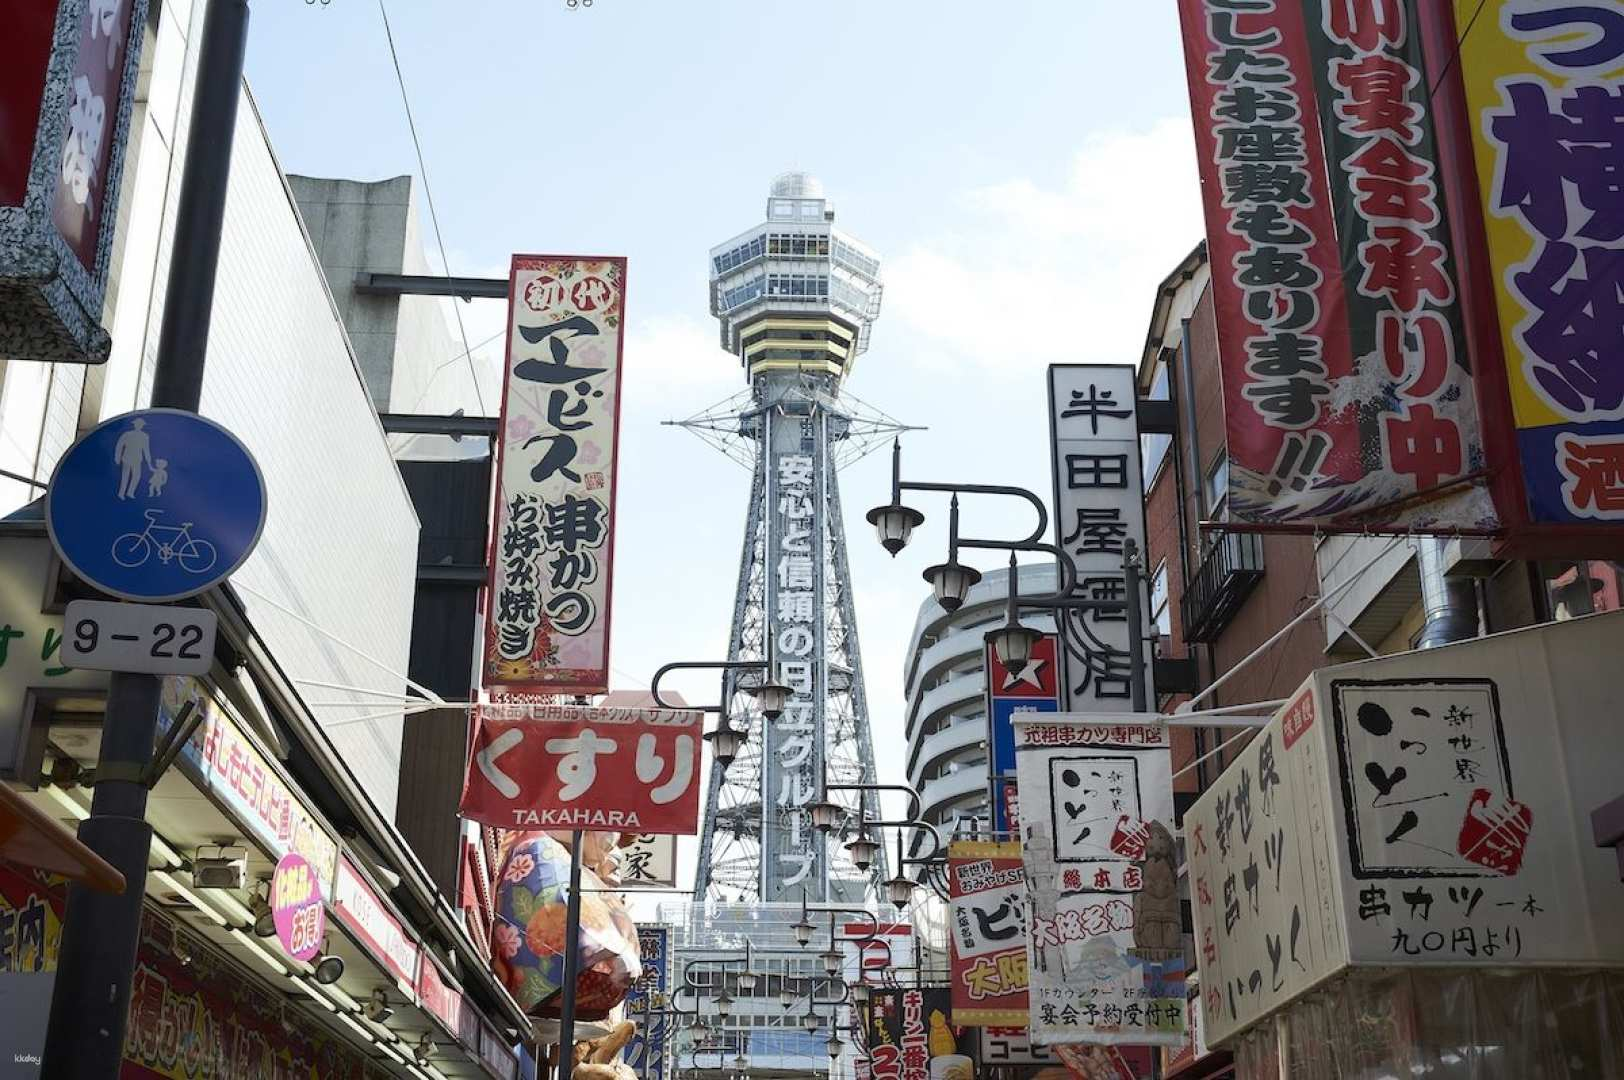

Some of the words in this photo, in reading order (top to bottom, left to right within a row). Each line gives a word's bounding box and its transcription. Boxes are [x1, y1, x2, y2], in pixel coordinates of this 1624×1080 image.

[524, 276, 612, 312] 初代
[496, 493, 543, 658] お好み焼き
[543, 494, 608, 637] 串かつ
[776, 454, 816, 886] 安心と信頼の日立グループ
[1024, 725, 1163, 745] 元祖串カツ専門店
[1442, 702, 1488, 784] 新世界
[476, 727, 695, 805] くすり
[512, 809, 641, 828] TAKAHARA
[625, 834, 657, 880] 家
[1062, 867, 1144, 890] 総本店
[1038, 1003, 1181, 1028] 宴会予約受付中
